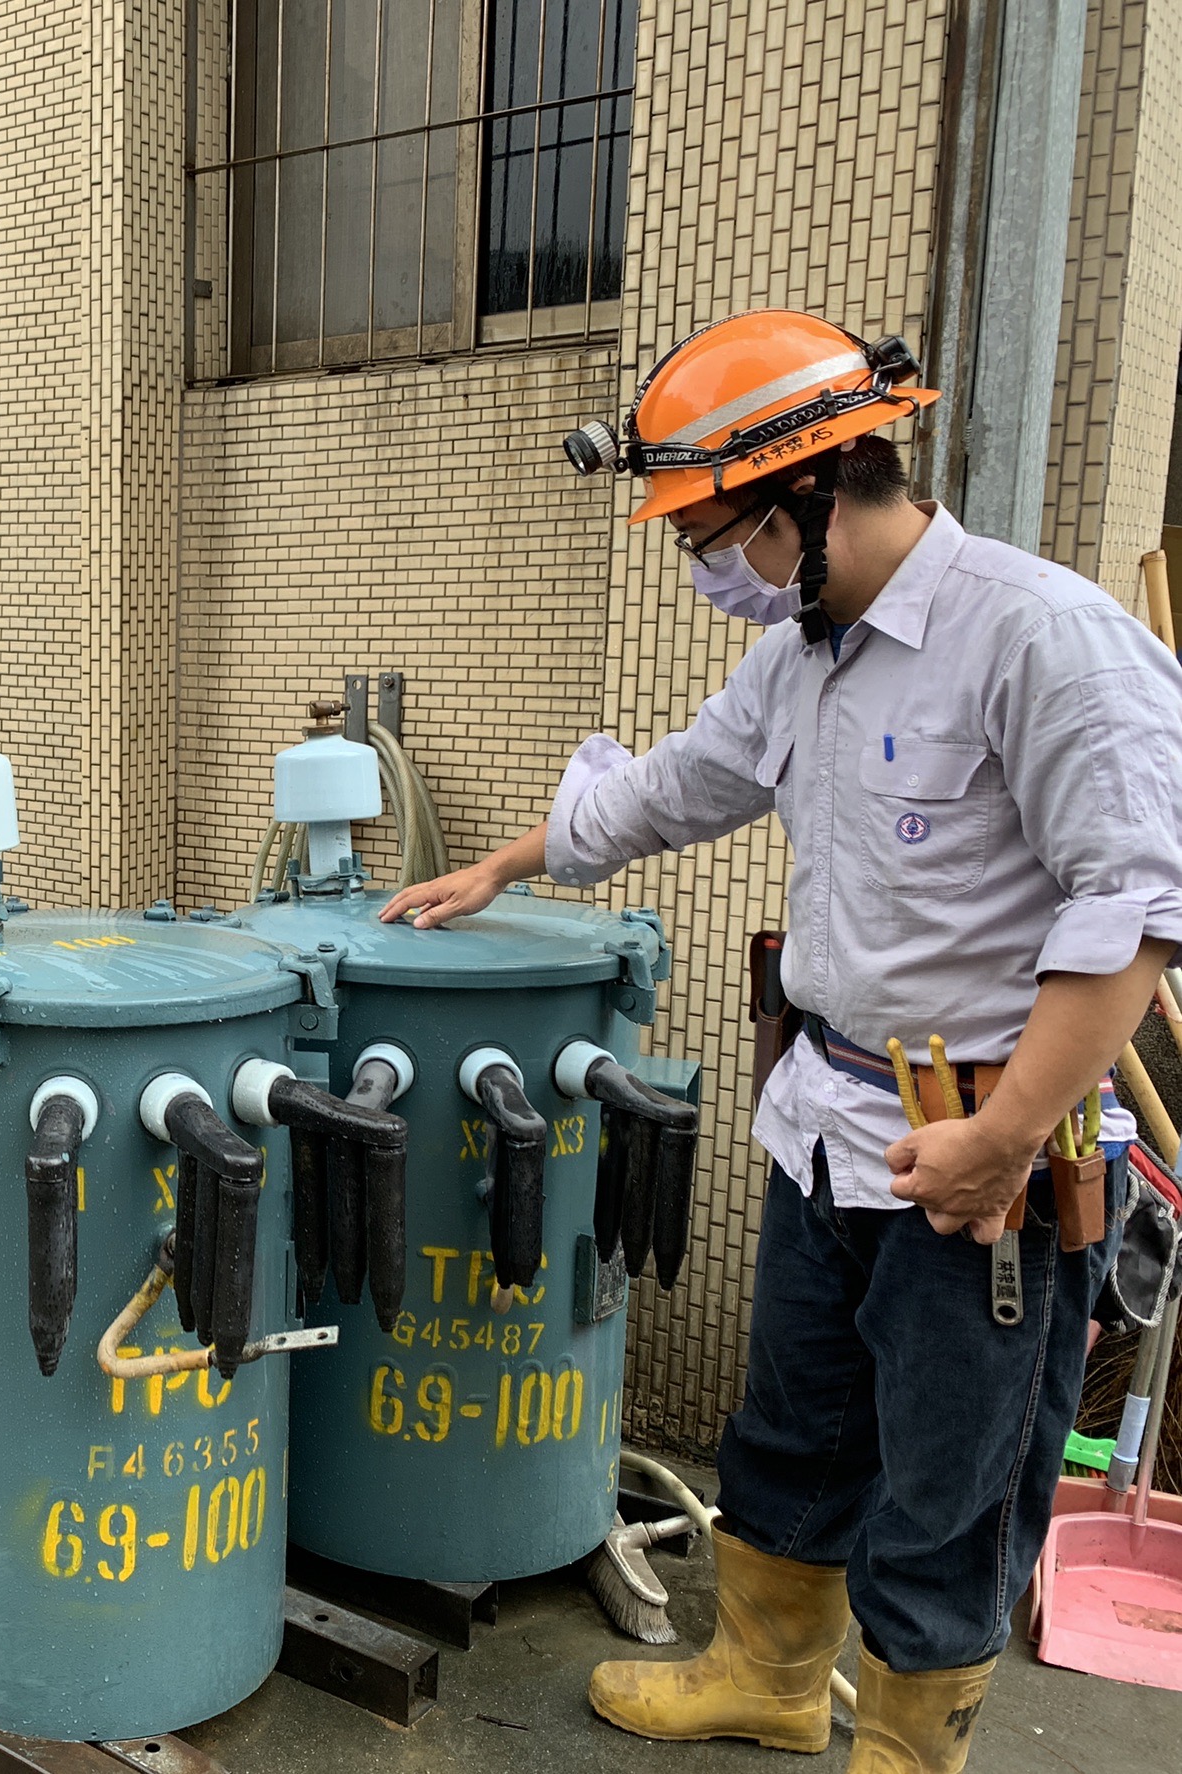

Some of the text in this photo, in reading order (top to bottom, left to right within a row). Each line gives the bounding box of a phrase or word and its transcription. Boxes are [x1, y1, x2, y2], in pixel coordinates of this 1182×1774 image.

[810, 426, 834, 446] A5
[551, 1114, 586, 1158] X3
[391, 1310, 546, 1355] G45487
[369, 1364, 584, 1448] 6.9-100
